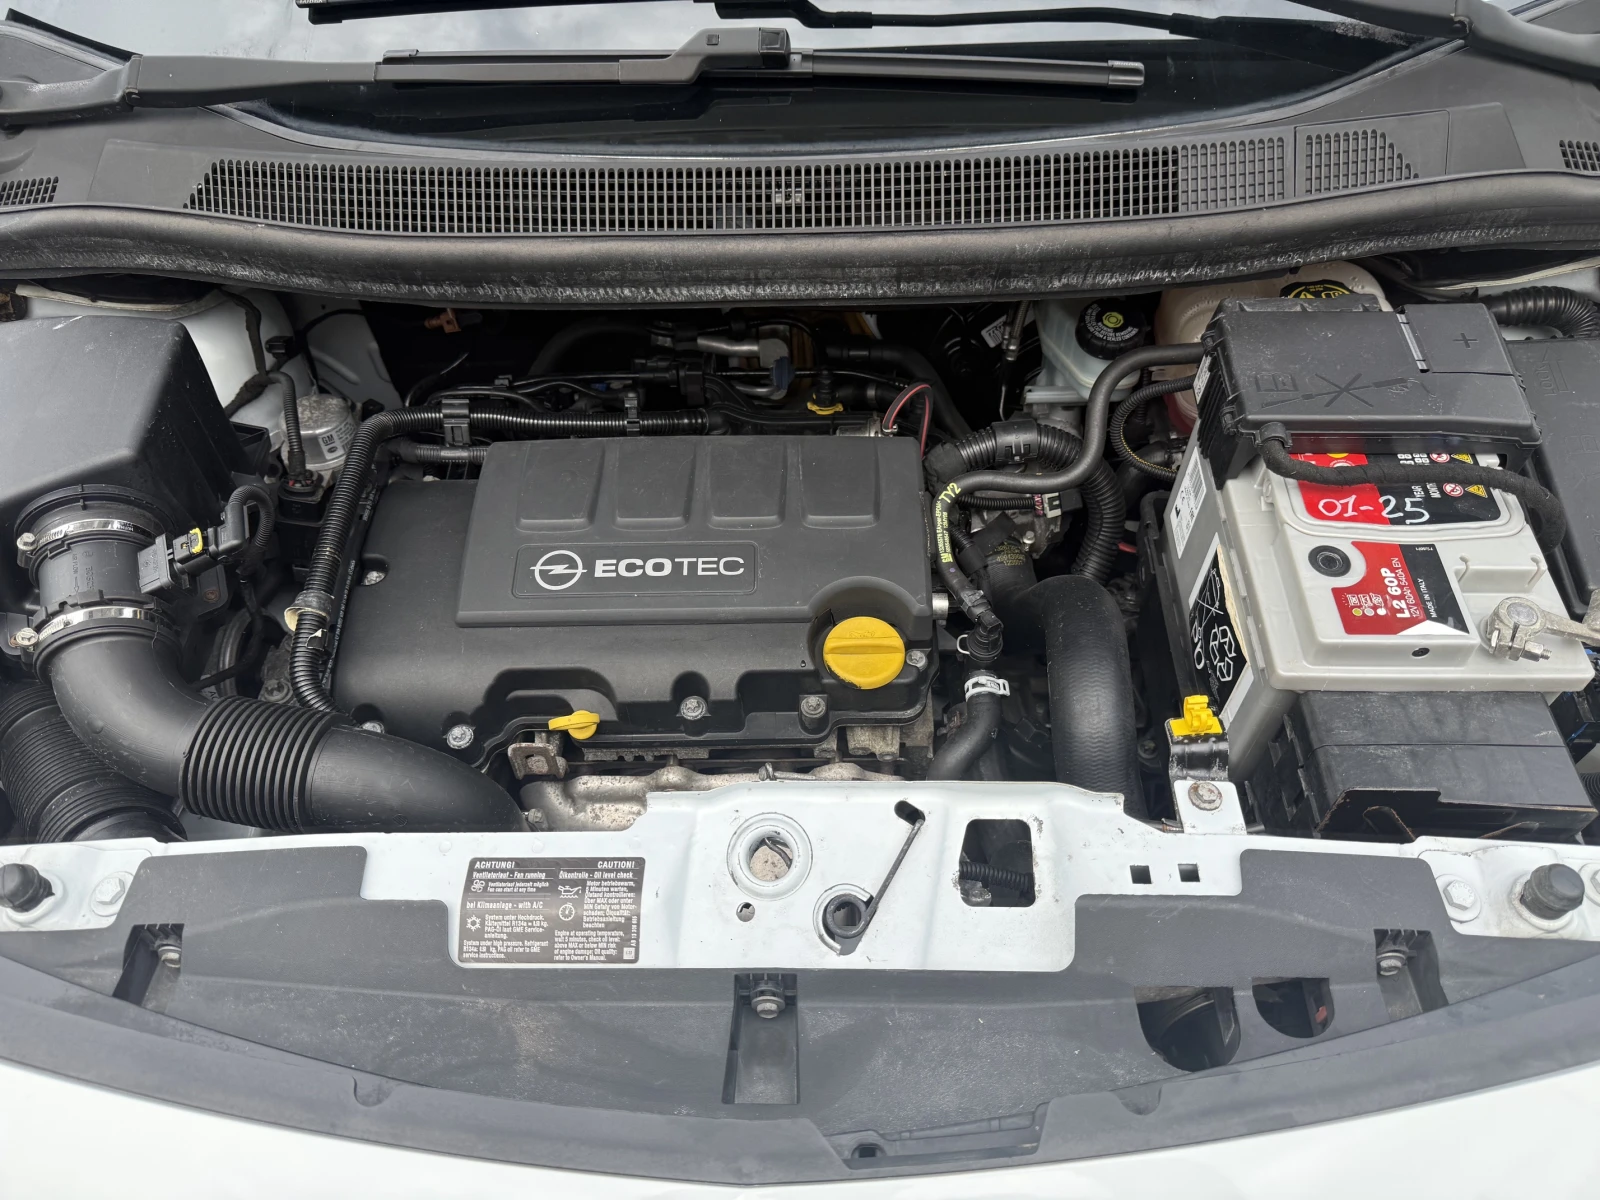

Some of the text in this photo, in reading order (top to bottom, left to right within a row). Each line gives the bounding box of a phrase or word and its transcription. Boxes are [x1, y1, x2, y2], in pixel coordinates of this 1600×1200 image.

[322, 434, 334, 446] GM
[939, 482, 961, 503] TY2
[1412, 486, 1425, 498] YEAR
[595, 557, 744, 577] ECOTEC
[1380, 568, 1411, 618] L2 60P
[1391, 558, 1419, 617] 12V 60Ah 540A EN
[1417, 578, 1428, 593] ITALY
[1426, 601, 1437, 618] MADE
